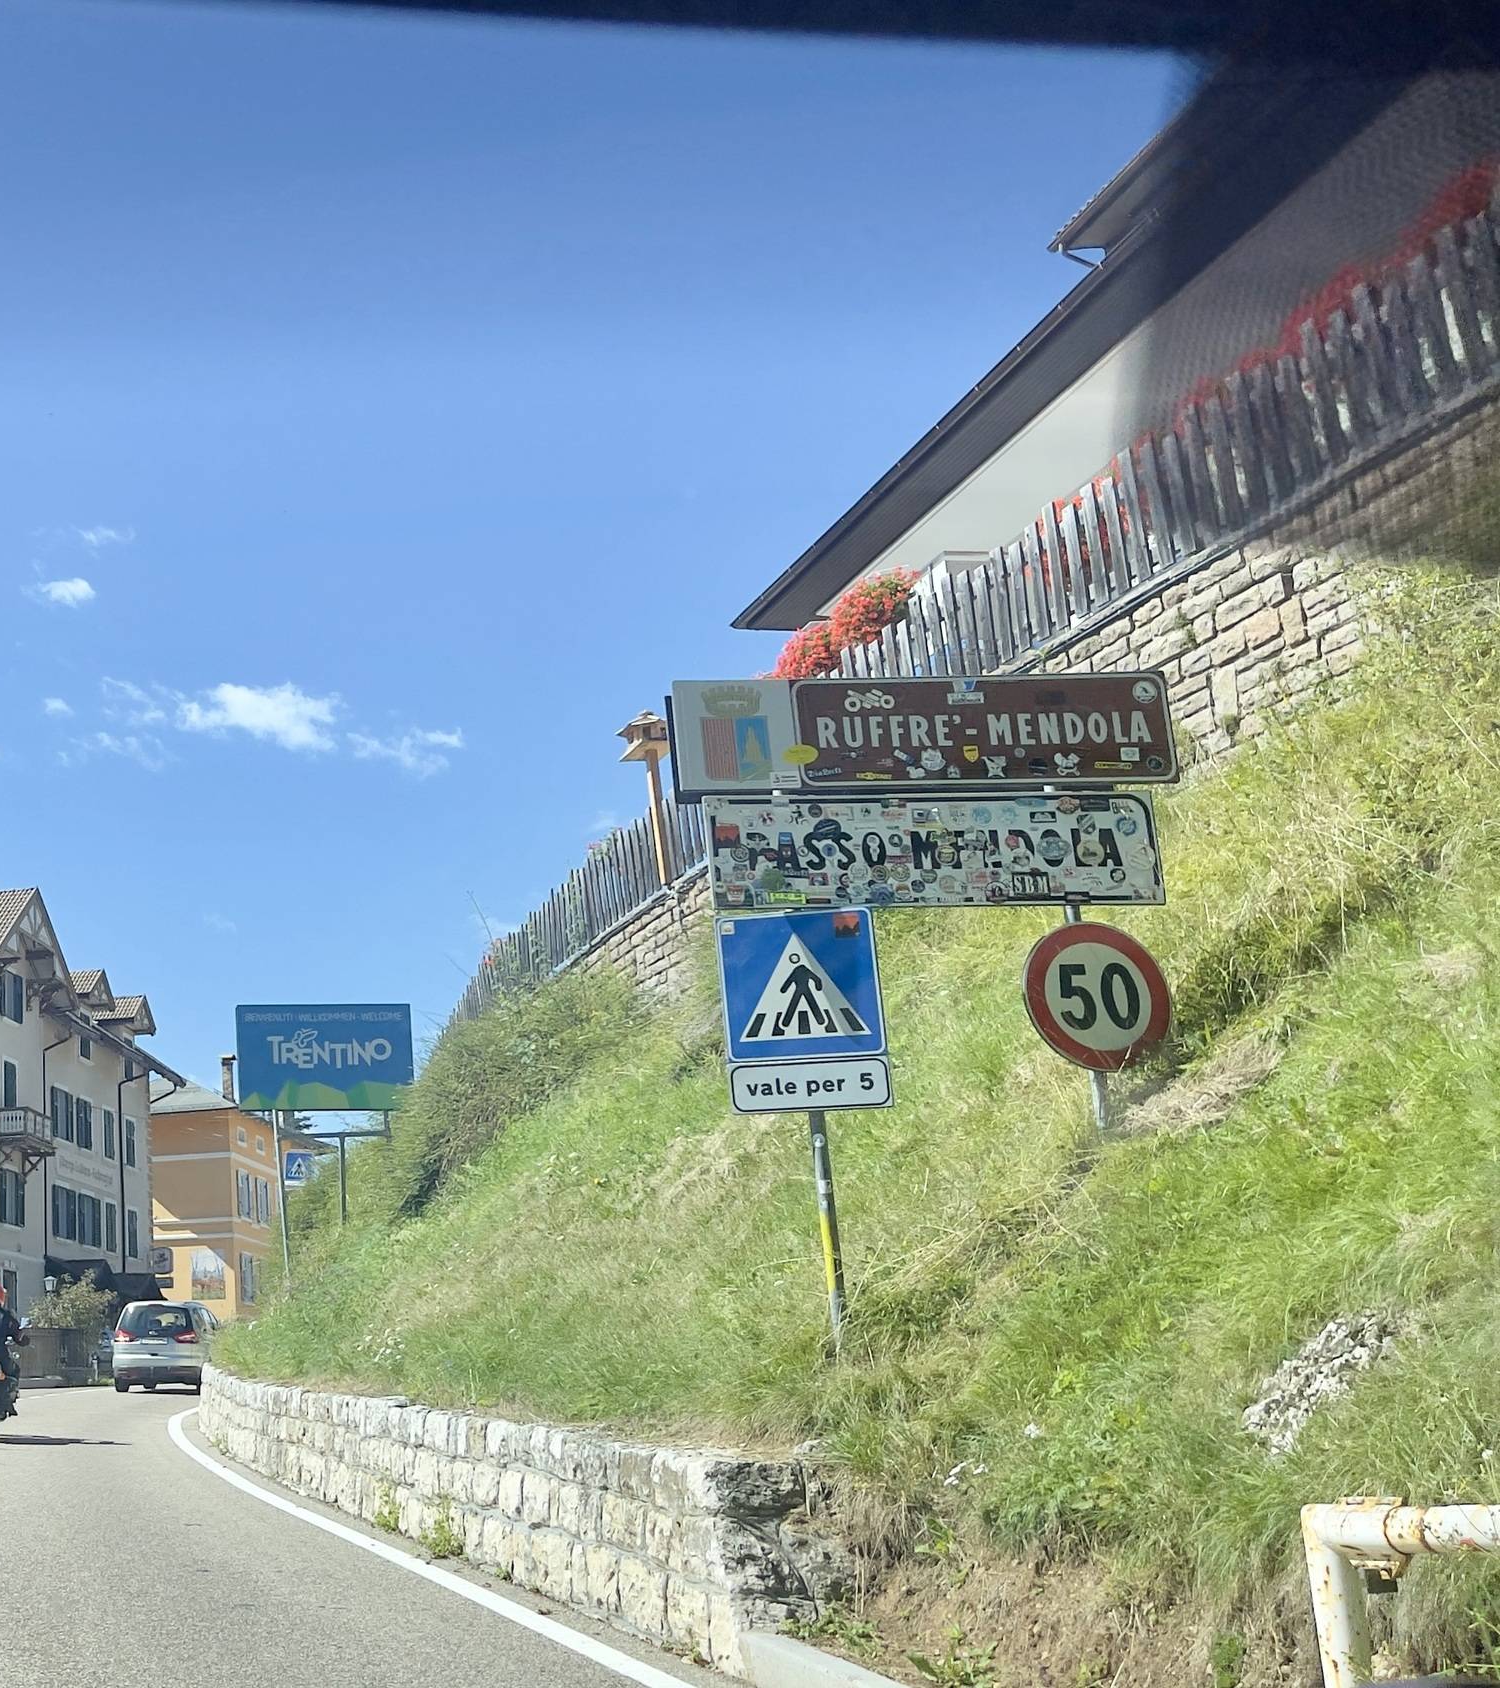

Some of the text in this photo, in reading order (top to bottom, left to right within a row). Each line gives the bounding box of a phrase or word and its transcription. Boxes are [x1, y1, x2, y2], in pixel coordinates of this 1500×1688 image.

[1058, 962, 1140, 1031] 50
[266, 1036, 392, 1069] TRENTINO
[746, 1072, 874, 1097] vale per 5
